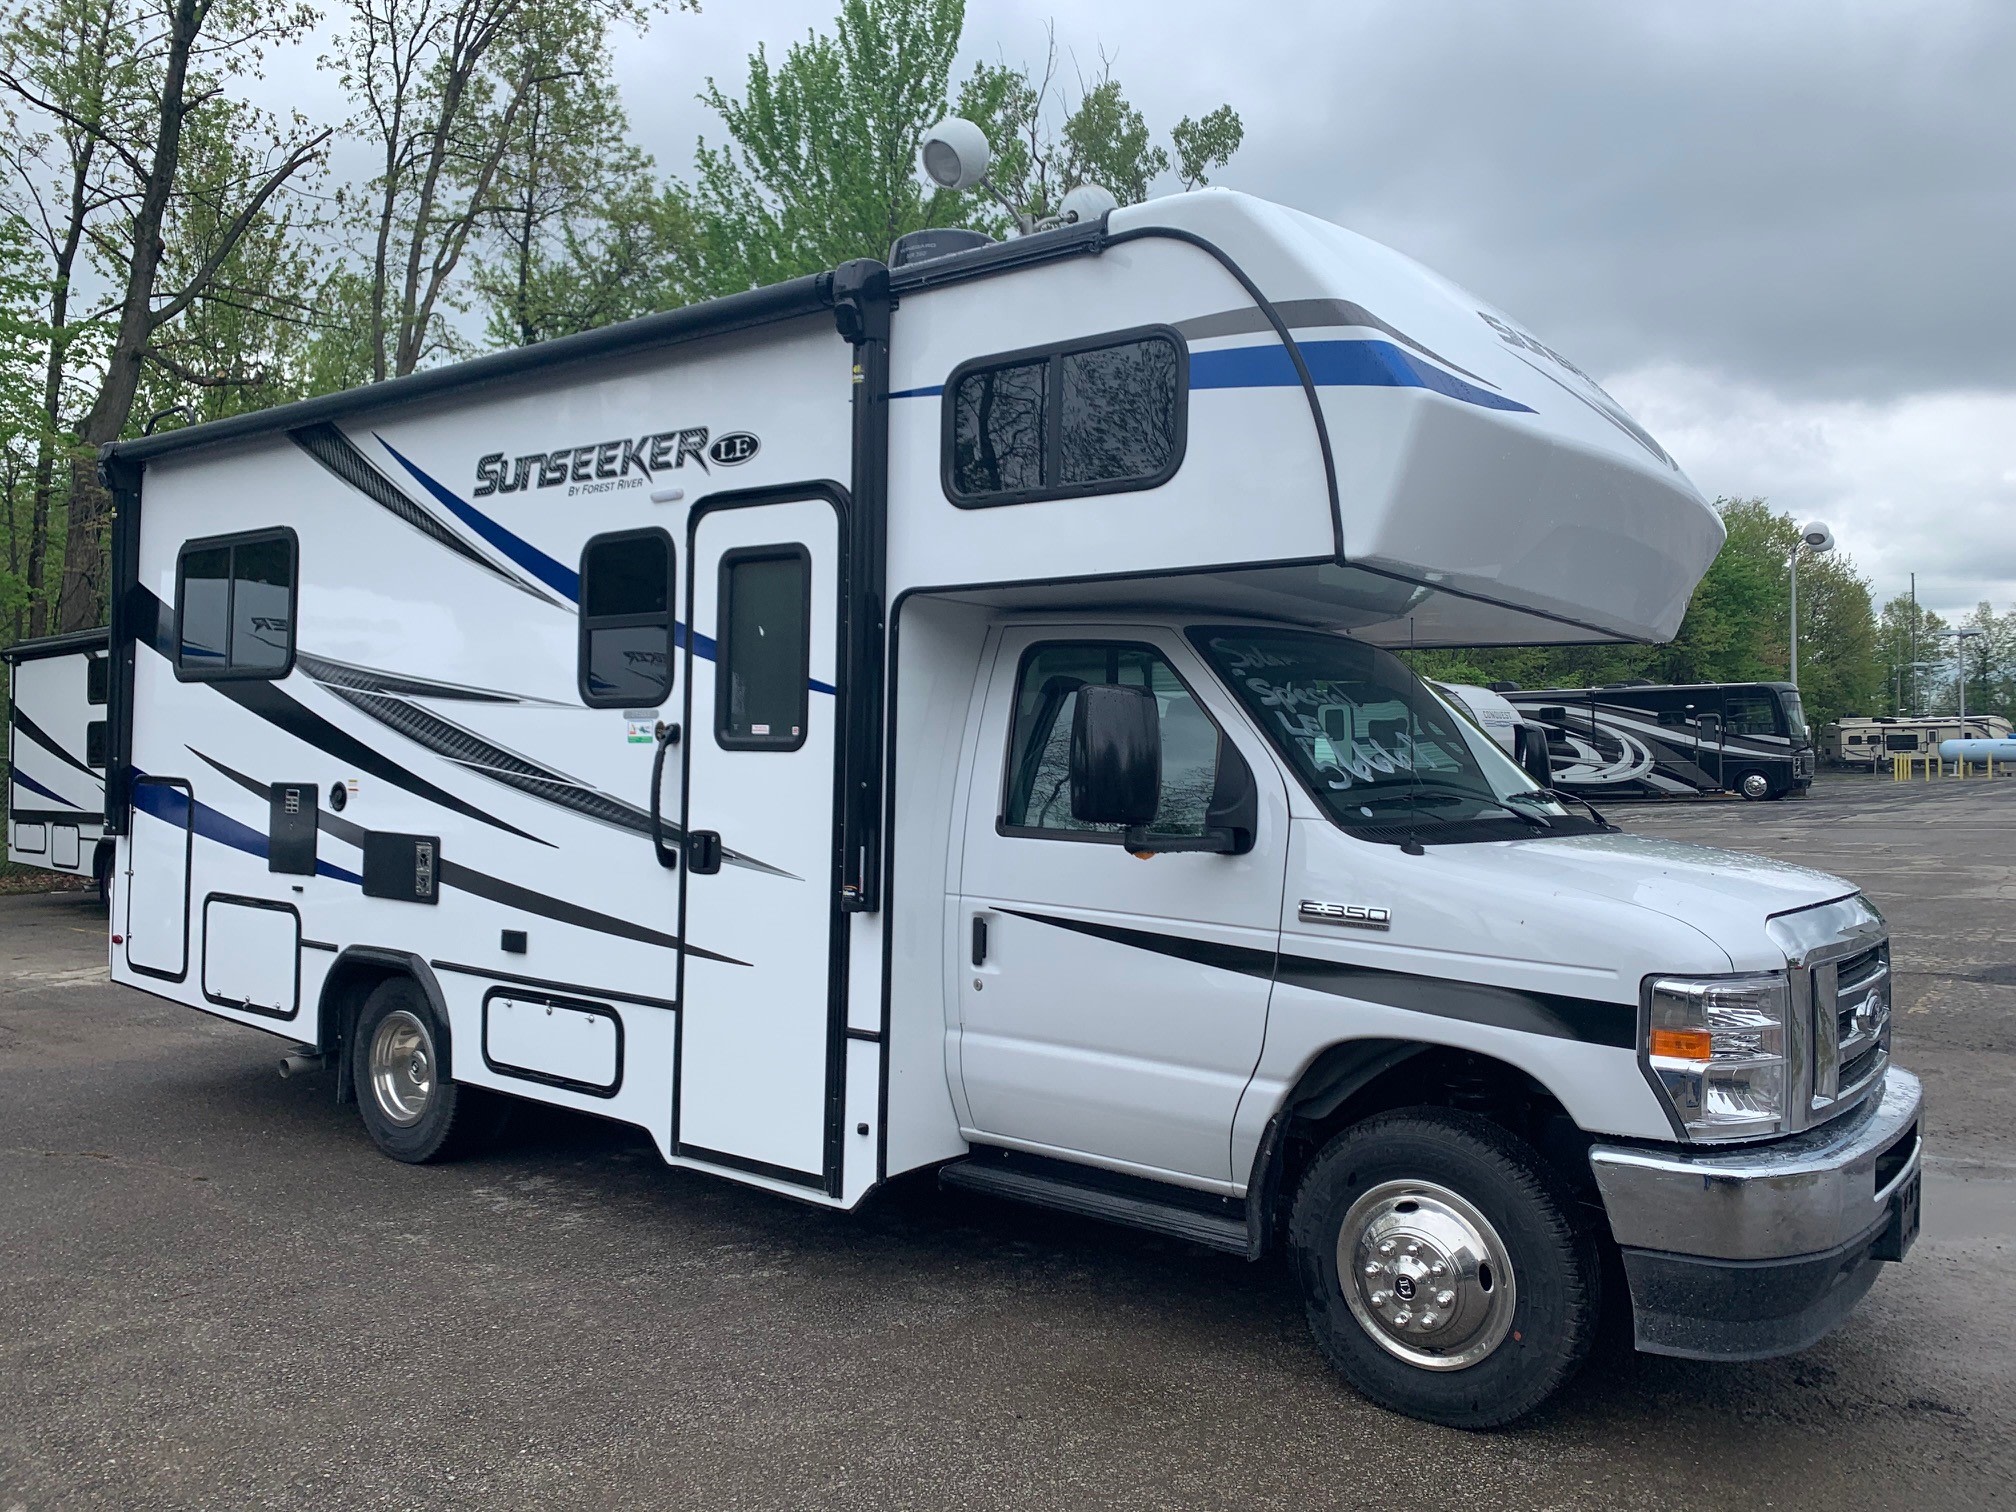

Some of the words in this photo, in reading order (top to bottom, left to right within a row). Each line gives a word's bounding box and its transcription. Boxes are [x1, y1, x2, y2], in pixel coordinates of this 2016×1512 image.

[717, 436, 751, 461] LE
[568, 486, 580, 497] BY
[581, 482, 615, 495] FOREST
[617, 478, 643, 490] RIVER
